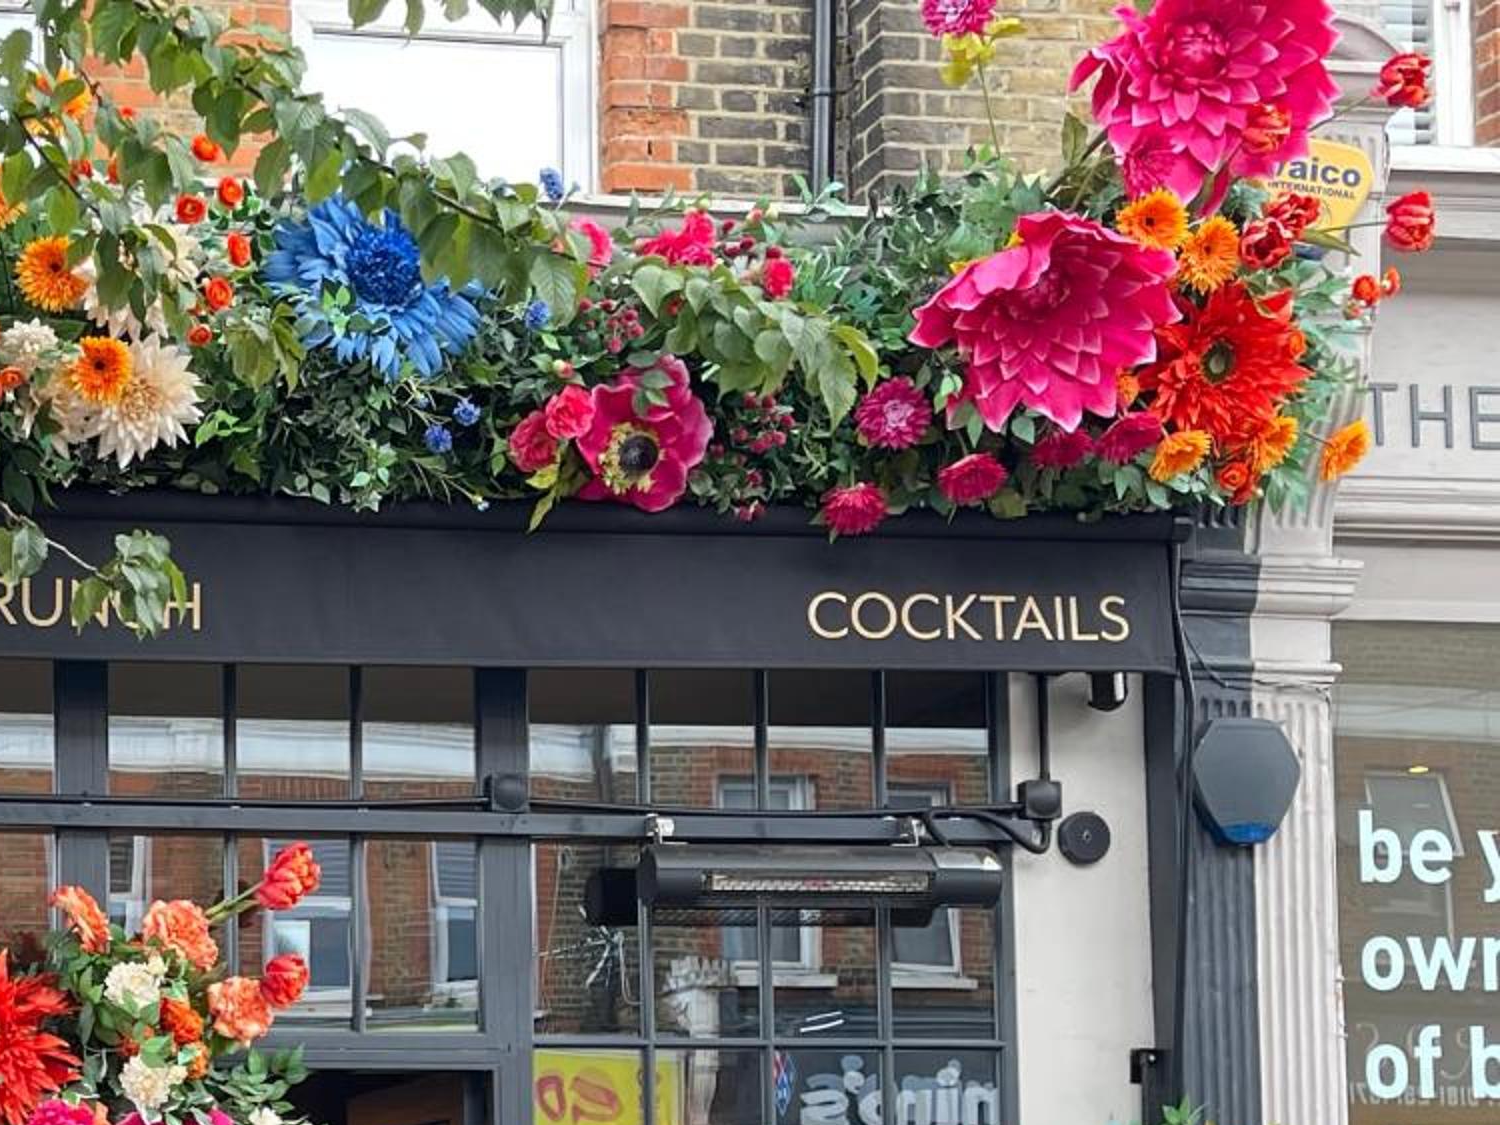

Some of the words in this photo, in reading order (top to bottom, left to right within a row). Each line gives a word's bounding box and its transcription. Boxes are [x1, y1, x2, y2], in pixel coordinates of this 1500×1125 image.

[1368, 382, 1500, 450] THE
[807, 591, 1130, 642] COCKTAILS
[1358, 809, 1453, 883] be
[1366, 1024, 1443, 1098] of
